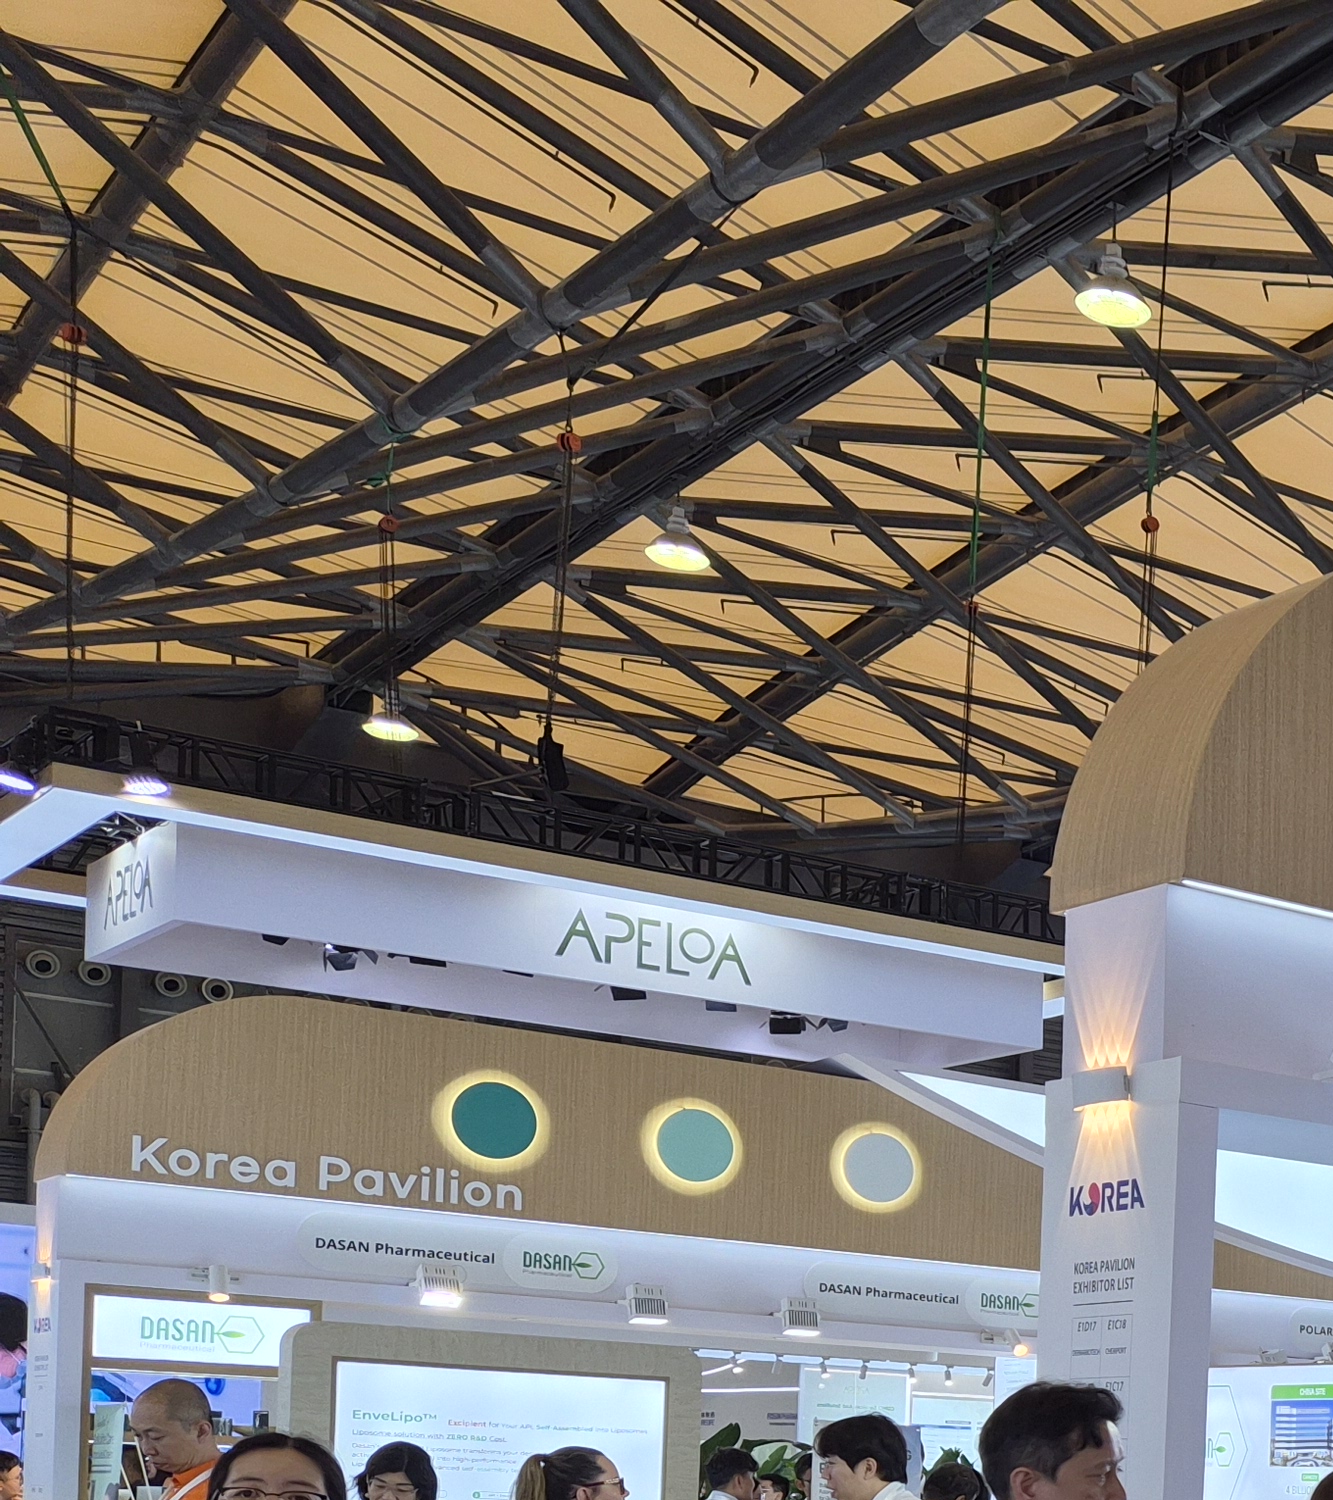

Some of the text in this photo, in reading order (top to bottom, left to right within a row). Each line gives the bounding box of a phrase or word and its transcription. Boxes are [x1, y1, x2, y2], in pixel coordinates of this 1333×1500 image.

[104, 855, 153, 930] APELOA
[555, 907, 752, 986] APELOA
[130, 1135, 523, 1211] Korea Pavilion
[1068, 1178, 1145, 1217] KOREA
[315, 1237, 495, 1265] DASAN Pharmaceutical
[522, 1250, 573, 1273] DASAN
[1073, 1257, 1135, 1275] KOREA PAVILION
[819, 1282, 959, 1305] DASAN Pharmaceutical
[1073, 1276, 1135, 1294] EXHIBITOR LIST
[981, 1292, 1020, 1311] DASAN
[140, 1315, 216, 1345] DASAN
[1077, 1319, 1127, 1333] E1D17 E1C18
[139, 1340, 216, 1354] Pharmaceutical
[448, 1419, 486, 1429] Excipient
